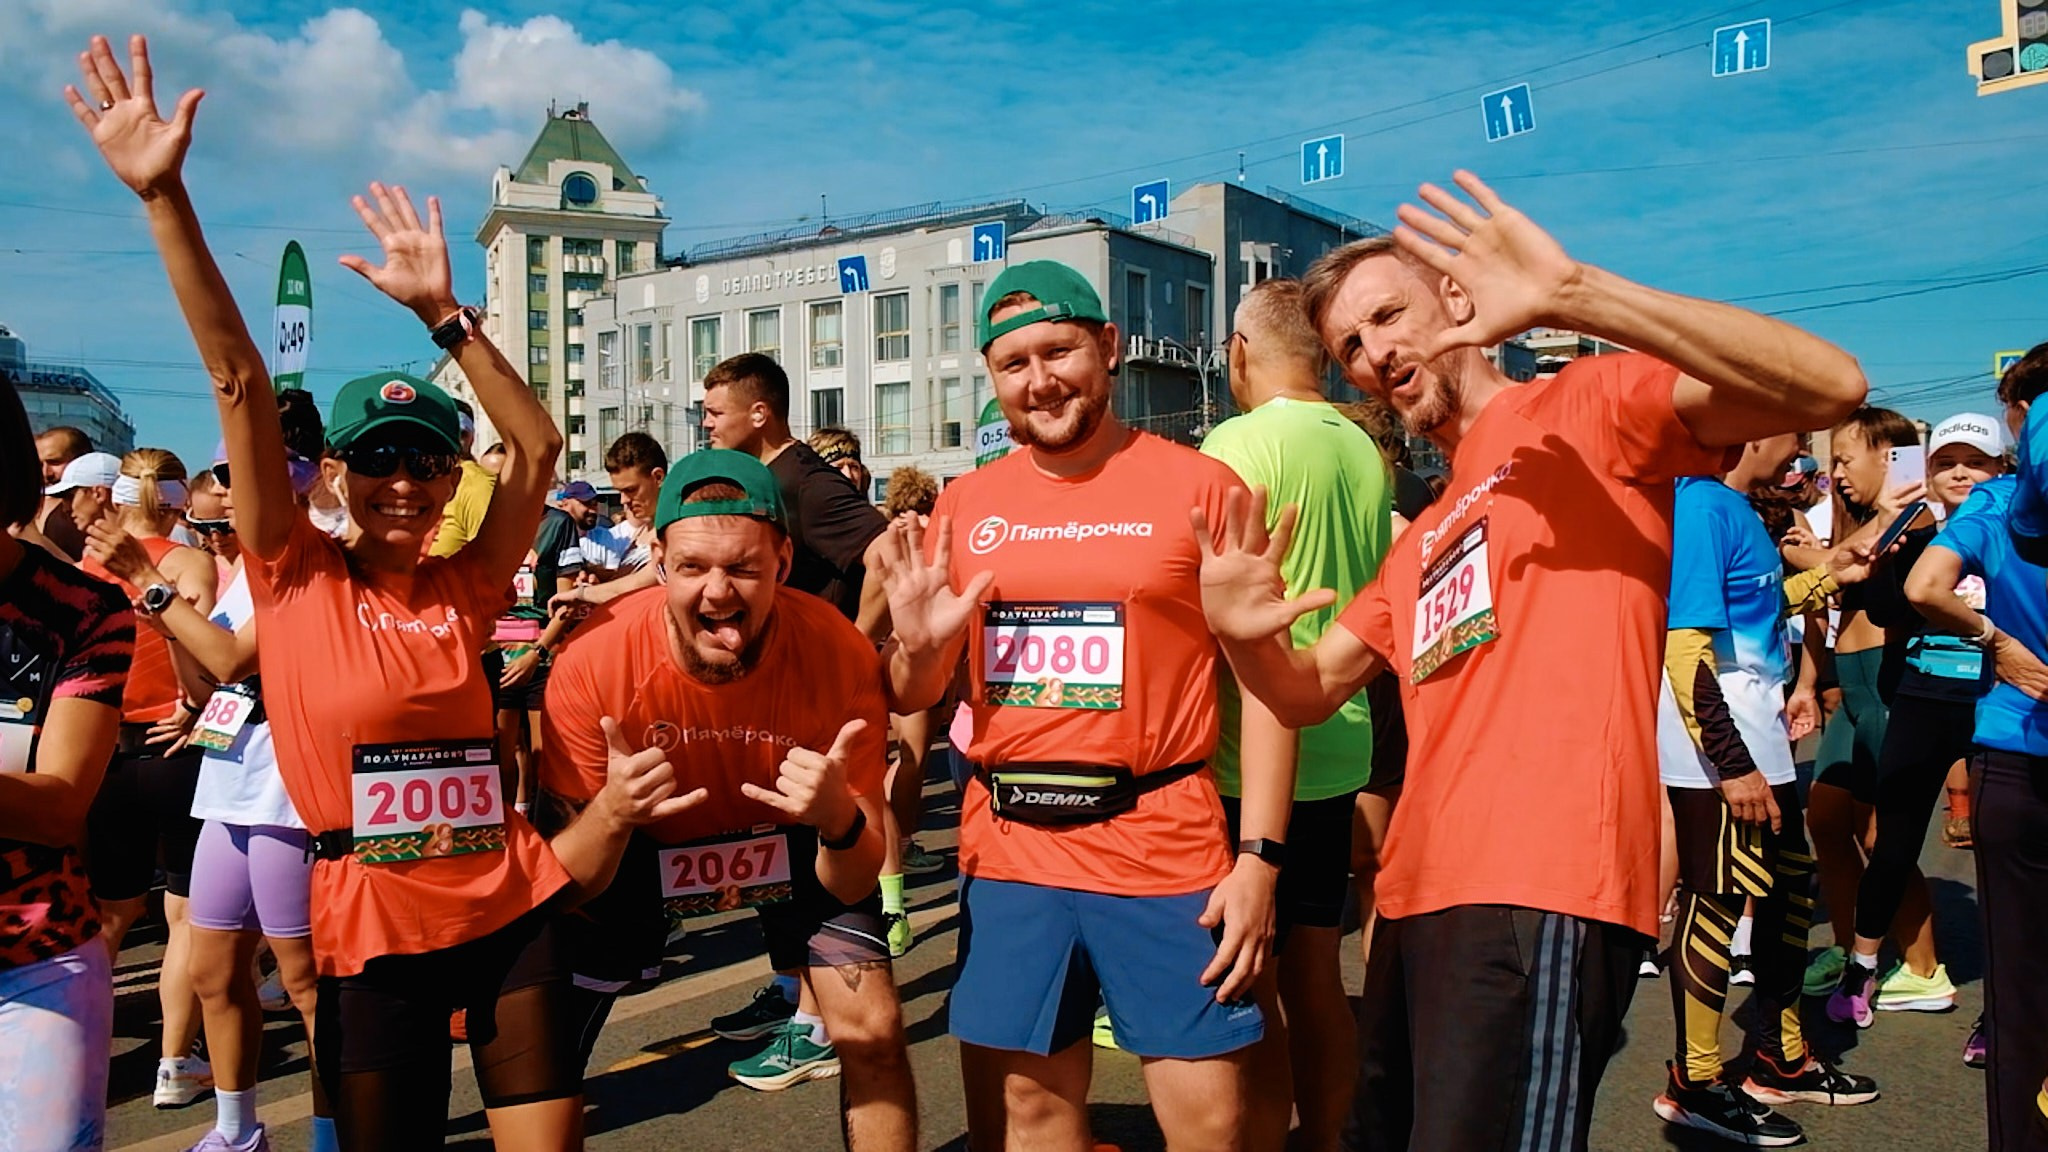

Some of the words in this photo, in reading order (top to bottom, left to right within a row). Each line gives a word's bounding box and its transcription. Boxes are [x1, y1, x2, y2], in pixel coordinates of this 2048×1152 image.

[722, 263, 838, 296] ОБЛПОТРЕБСО
[279, 321, 305, 353] 0:49
[1938, 422, 1989, 437] adidas
[1009, 521, 1153, 542] Пятёрочка
[1421, 563, 1475, 644] 1529
[992, 634, 1110, 675] 2080
[367, 775, 493, 825] 2003
[1025, 791, 1101, 807] DEMIX
[671, 842, 777, 889] 2067
